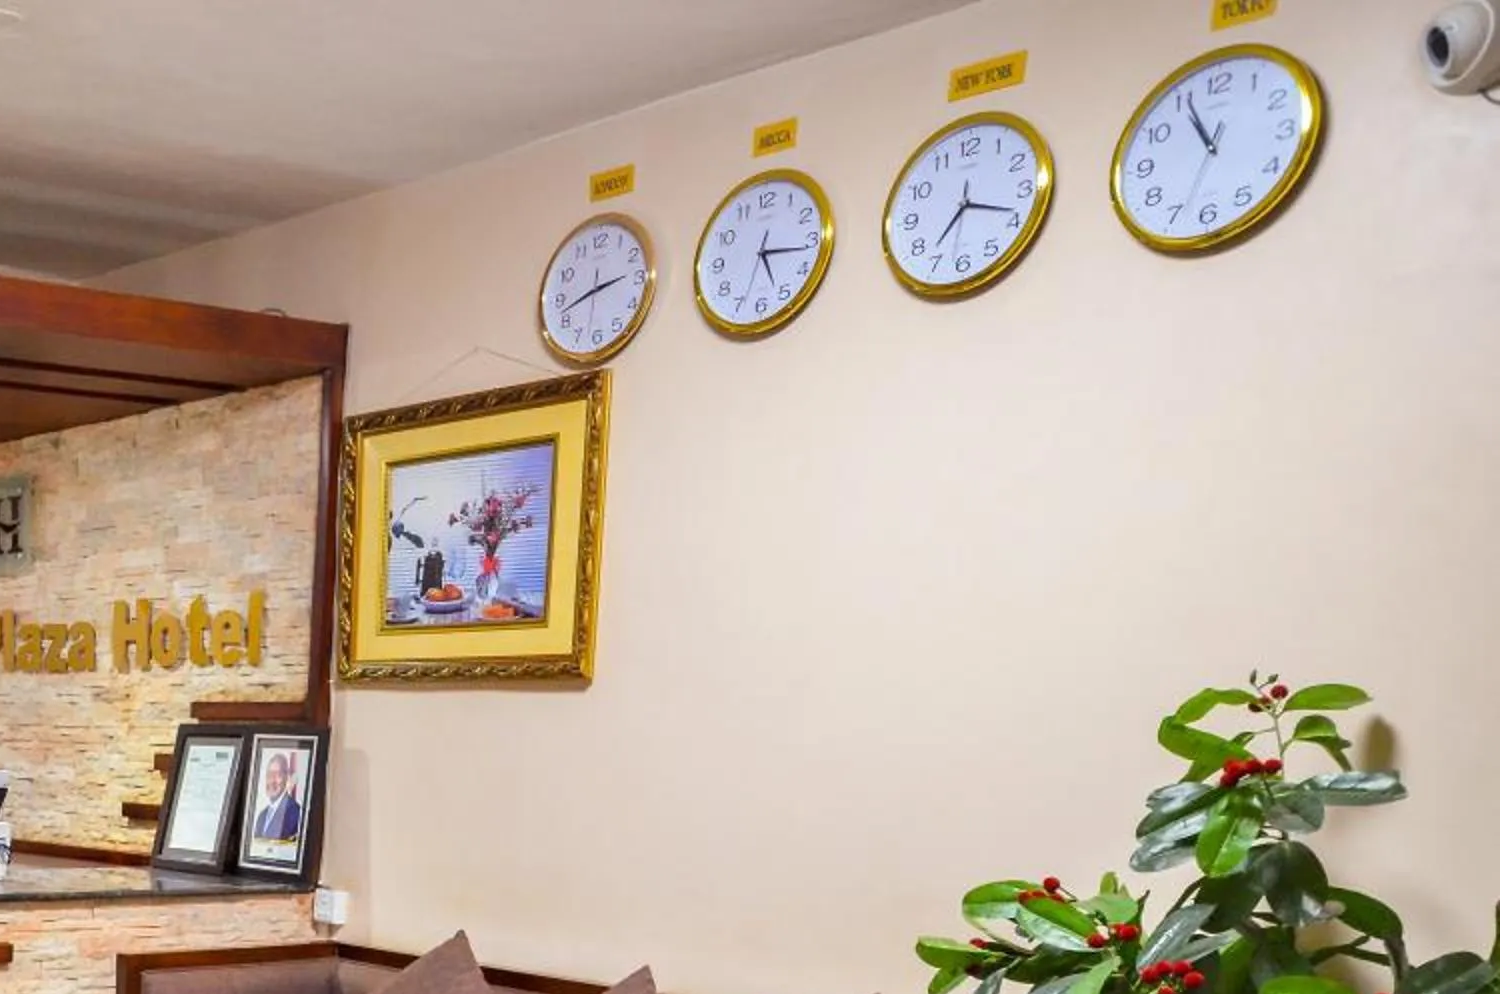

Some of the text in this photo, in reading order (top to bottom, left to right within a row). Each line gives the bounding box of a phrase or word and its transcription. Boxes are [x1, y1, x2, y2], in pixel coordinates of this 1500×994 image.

[954, 62, 1015, 94] NEW YORK
[1207, 72, 1233, 96] 12
[1267, 88, 1287, 111] 2
[1147, 123, 1171, 144] 10
[1275, 118, 1296, 141] 3
[960, 137, 981, 158] 12
[935, 153, 949, 172] 11
[1009, 153, 1026, 173] 2
[1137, 159, 1155, 179] 9
[1263, 156, 1280, 174] 4
[912, 181, 933, 200] 10
[1016, 179, 1033, 199] 3
[1145, 186, 1162, 207] 8
[1235, 185, 1252, 207] 5
[759, 191, 776, 209] 12
[738, 203, 751, 221] 11
[799, 207, 813, 225] 2
[1006, 211, 1021, 229] 4
[1168, 205, 1184, 225] 7
[1199, 203, 1218, 225] 6
[903, 213, 919, 231] 9
[593, 233, 609, 249] 12
[718, 229, 736, 247] 10
[805, 231, 819, 249] 3
[575, 245, 587, 261] 11
[627, 247, 639, 263] 2
[911, 239, 925, 256] 8
[983, 239, 999, 258] 5
[712, 257, 725, 273] 9
[797, 262, 809, 277] 4
[929, 254, 943, 273] 7
[955, 255, 971, 273] 6
[560, 267, 575, 283] 10
[633, 269, 645, 285] 3
[718, 280, 731, 296] 8
[778, 284, 791, 301] 5
[555, 293, 566, 308] 9
[627, 296, 637, 310] 4
[734, 296, 746, 313] 7
[755, 298, 768, 313] 6
[561, 314, 571, 328] 8
[611, 318, 623, 333] 5
[574, 327, 583, 344] 7
[591, 329, 603, 345] 6
[111, 588, 267, 674] Hotel
